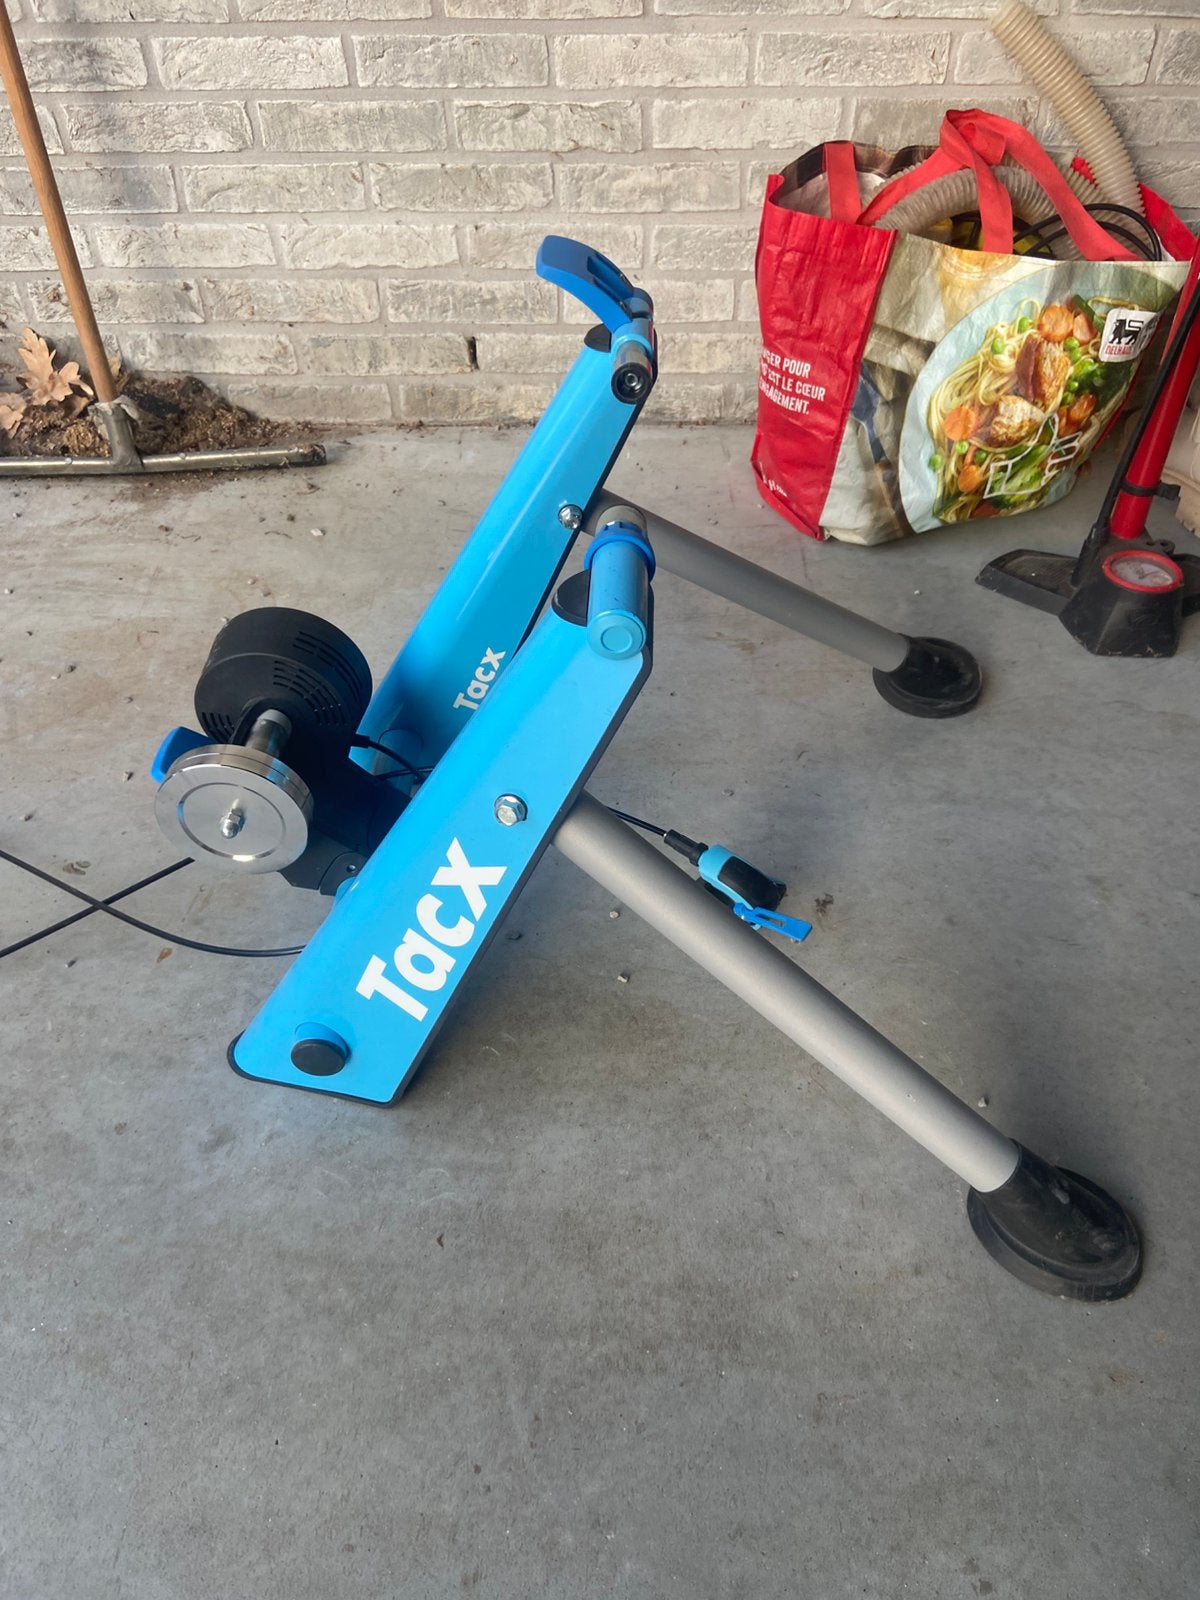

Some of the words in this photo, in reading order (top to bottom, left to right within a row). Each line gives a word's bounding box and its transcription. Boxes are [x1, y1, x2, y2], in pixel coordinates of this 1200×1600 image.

[781, 376, 793, 392] LE
[795, 381, 826, 402] CŒUR
[782, 357, 811, 378] POUR
[453, 646, 506, 710] Tacx
[355, 836, 508, 1022] Tacx
